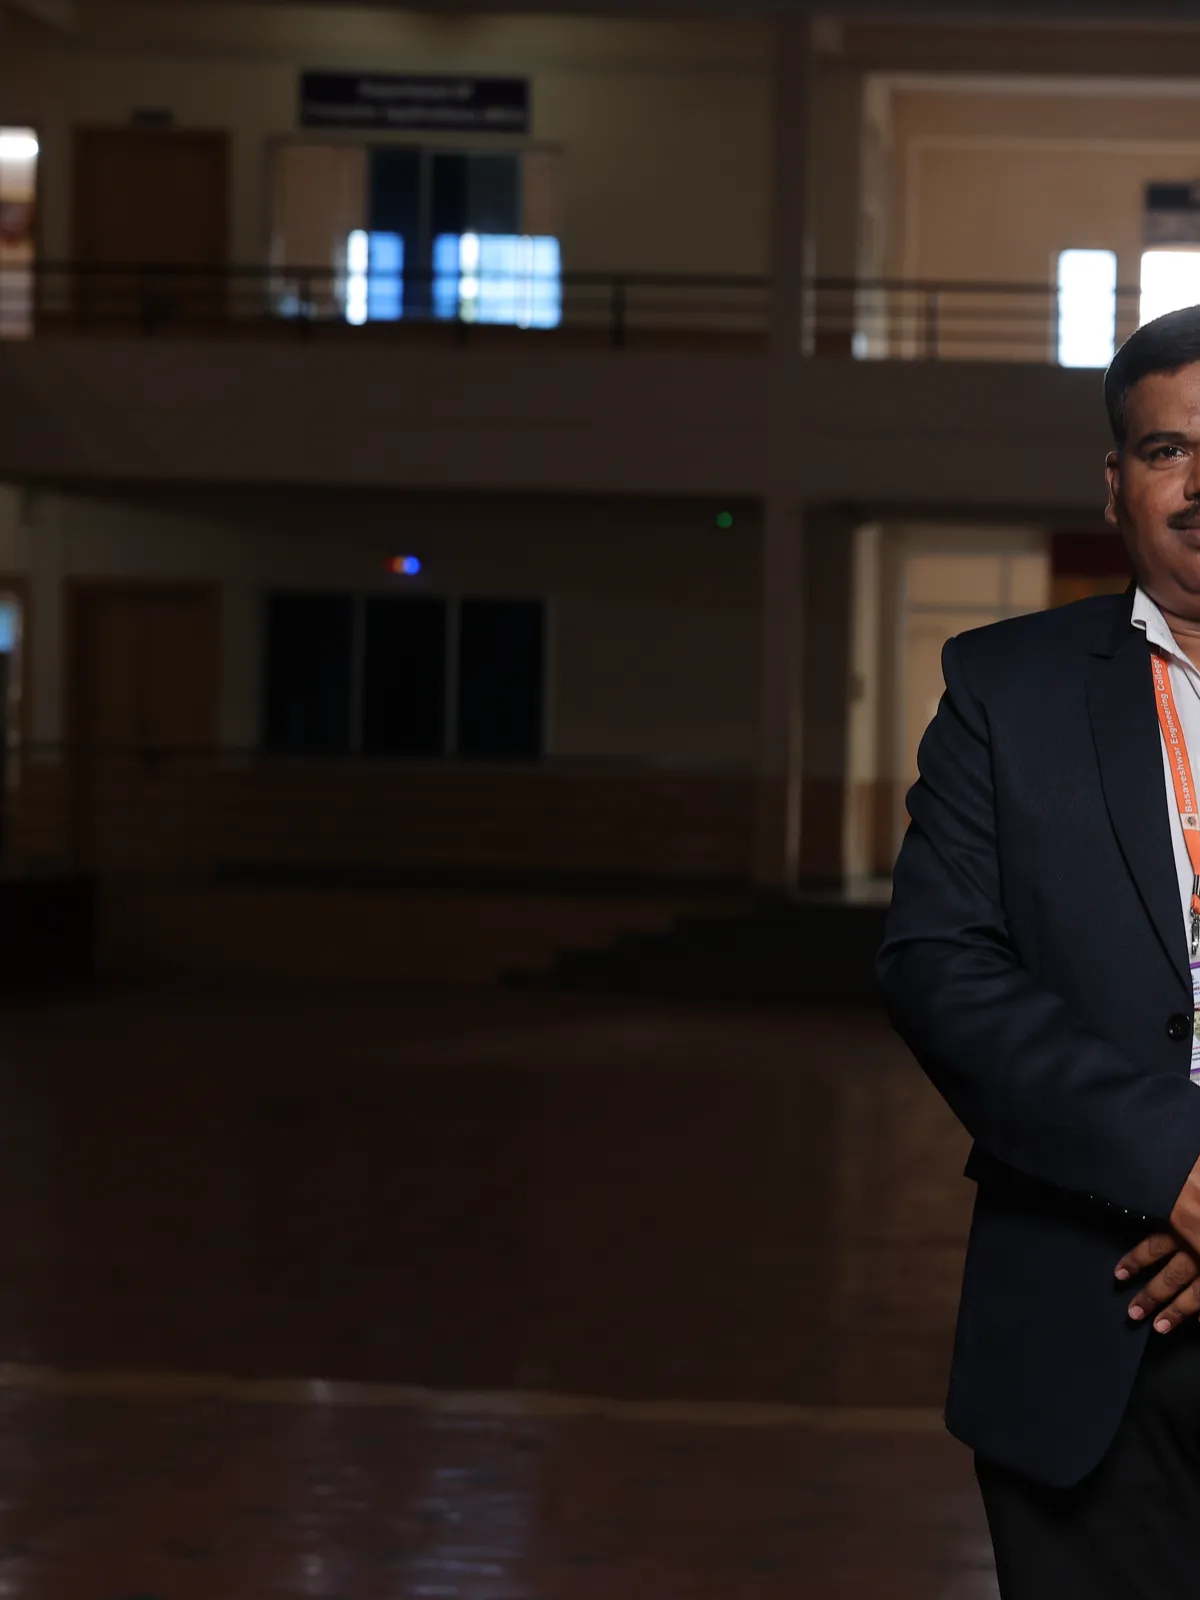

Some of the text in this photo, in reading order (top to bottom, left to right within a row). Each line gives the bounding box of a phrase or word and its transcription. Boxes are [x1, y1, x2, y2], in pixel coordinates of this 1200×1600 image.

[1153, 660, 1165, 691] College
[1161, 693, 1179, 744] Engineering
[1174, 747, 1193, 812] Basaveshwar
